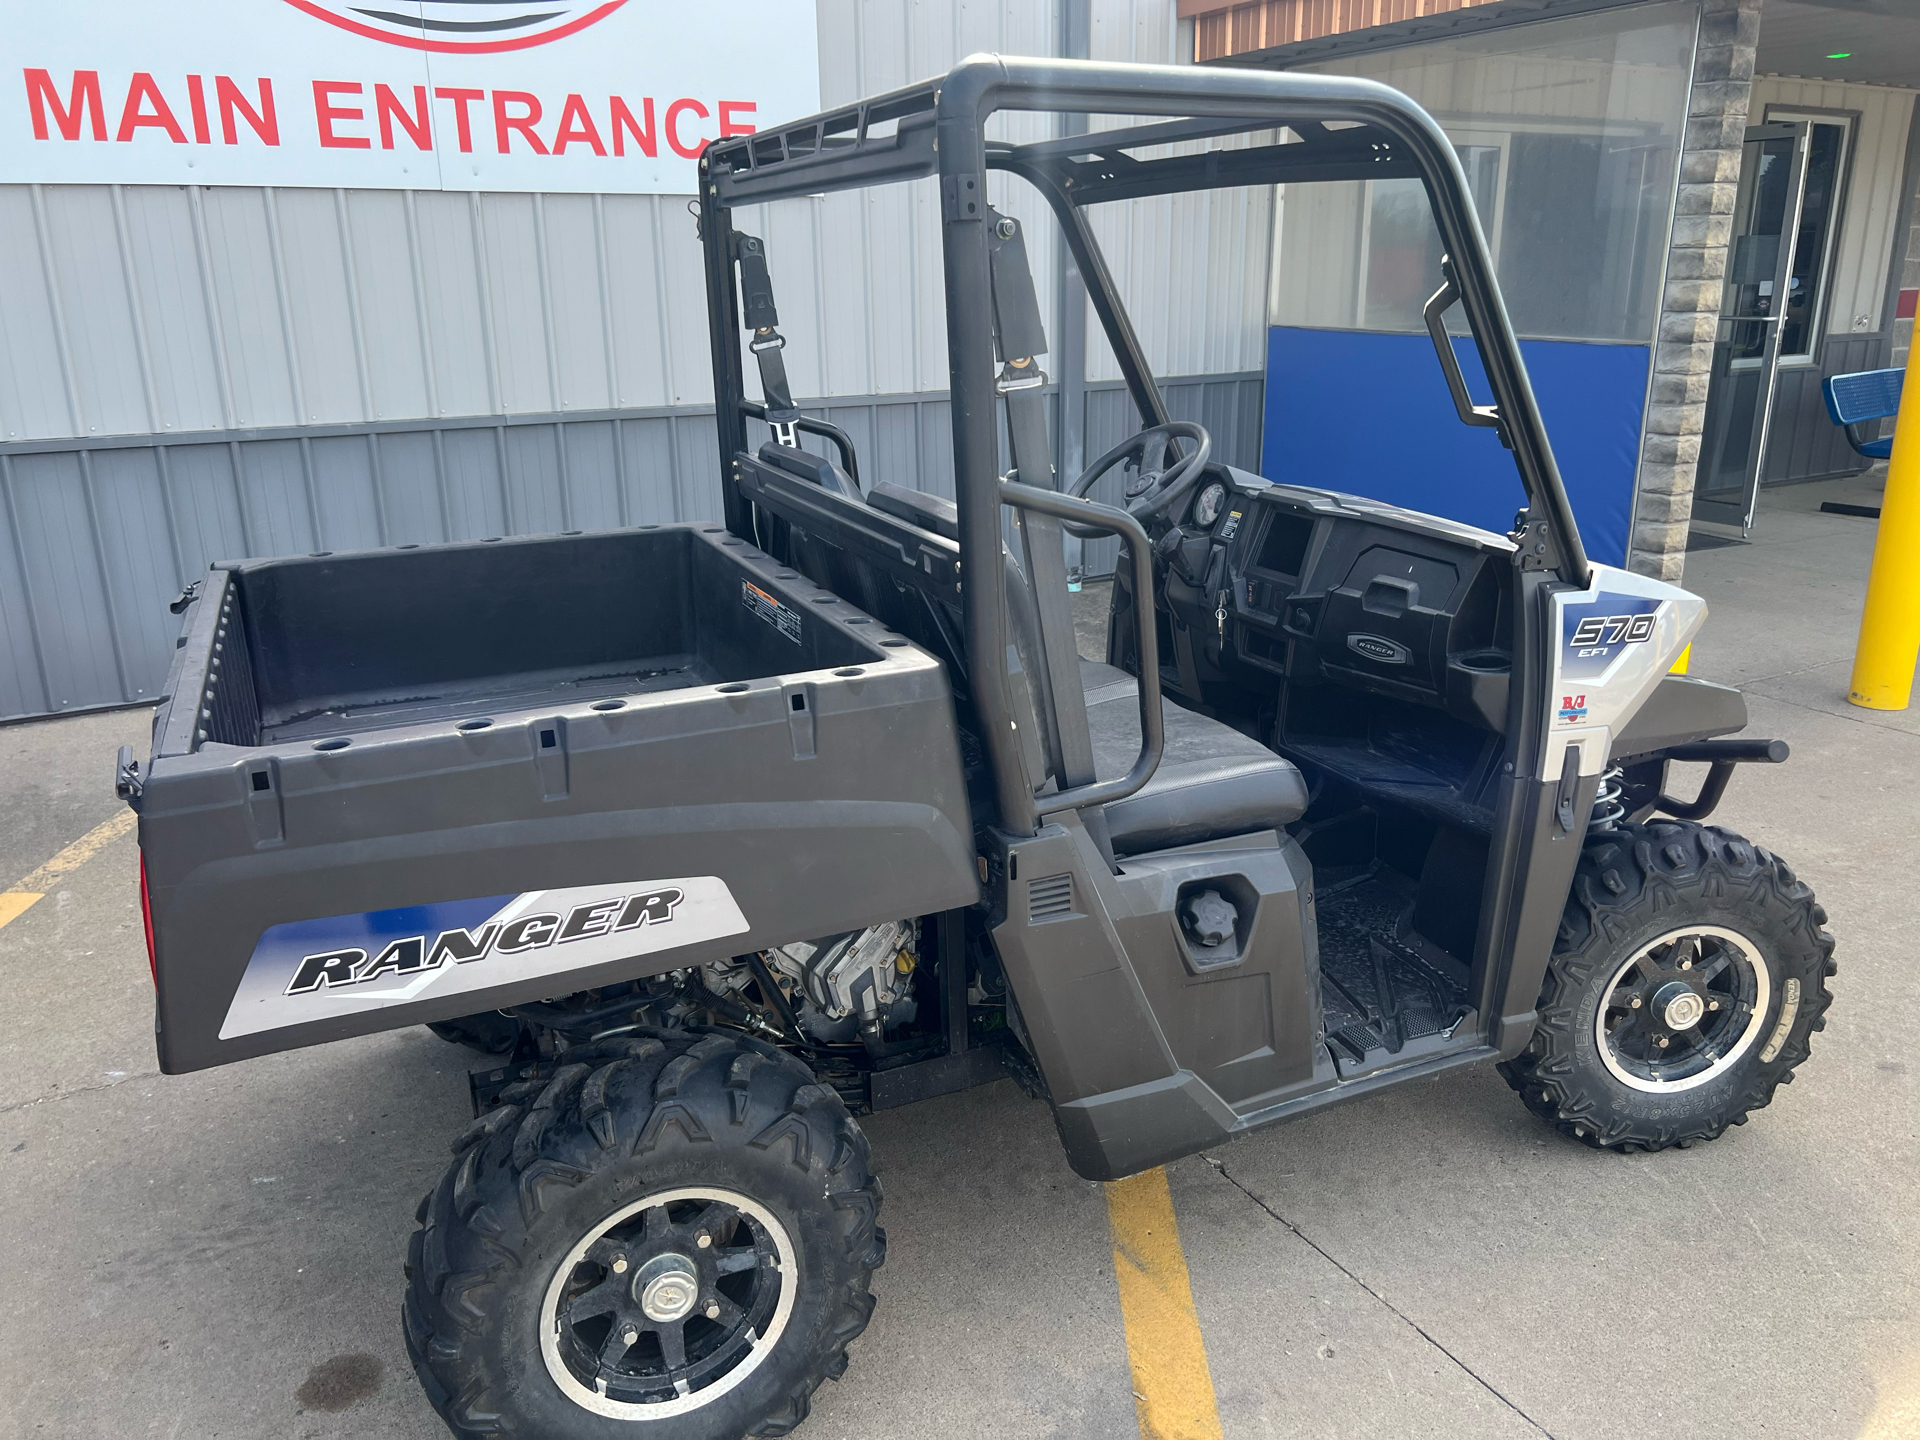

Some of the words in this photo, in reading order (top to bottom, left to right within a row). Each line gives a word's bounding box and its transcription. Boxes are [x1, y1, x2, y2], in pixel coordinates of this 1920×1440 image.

[23, 68, 280, 146] MAIN
[312, 80, 757, 159] ENTRANCE
[1358, 641, 1394, 656] RANGER
[1570, 613, 1657, 647] 570
[1577, 647, 1608, 657] EFI
[284, 887, 685, 995] RANGER
[1574, 977, 1605, 1068] KENDA
